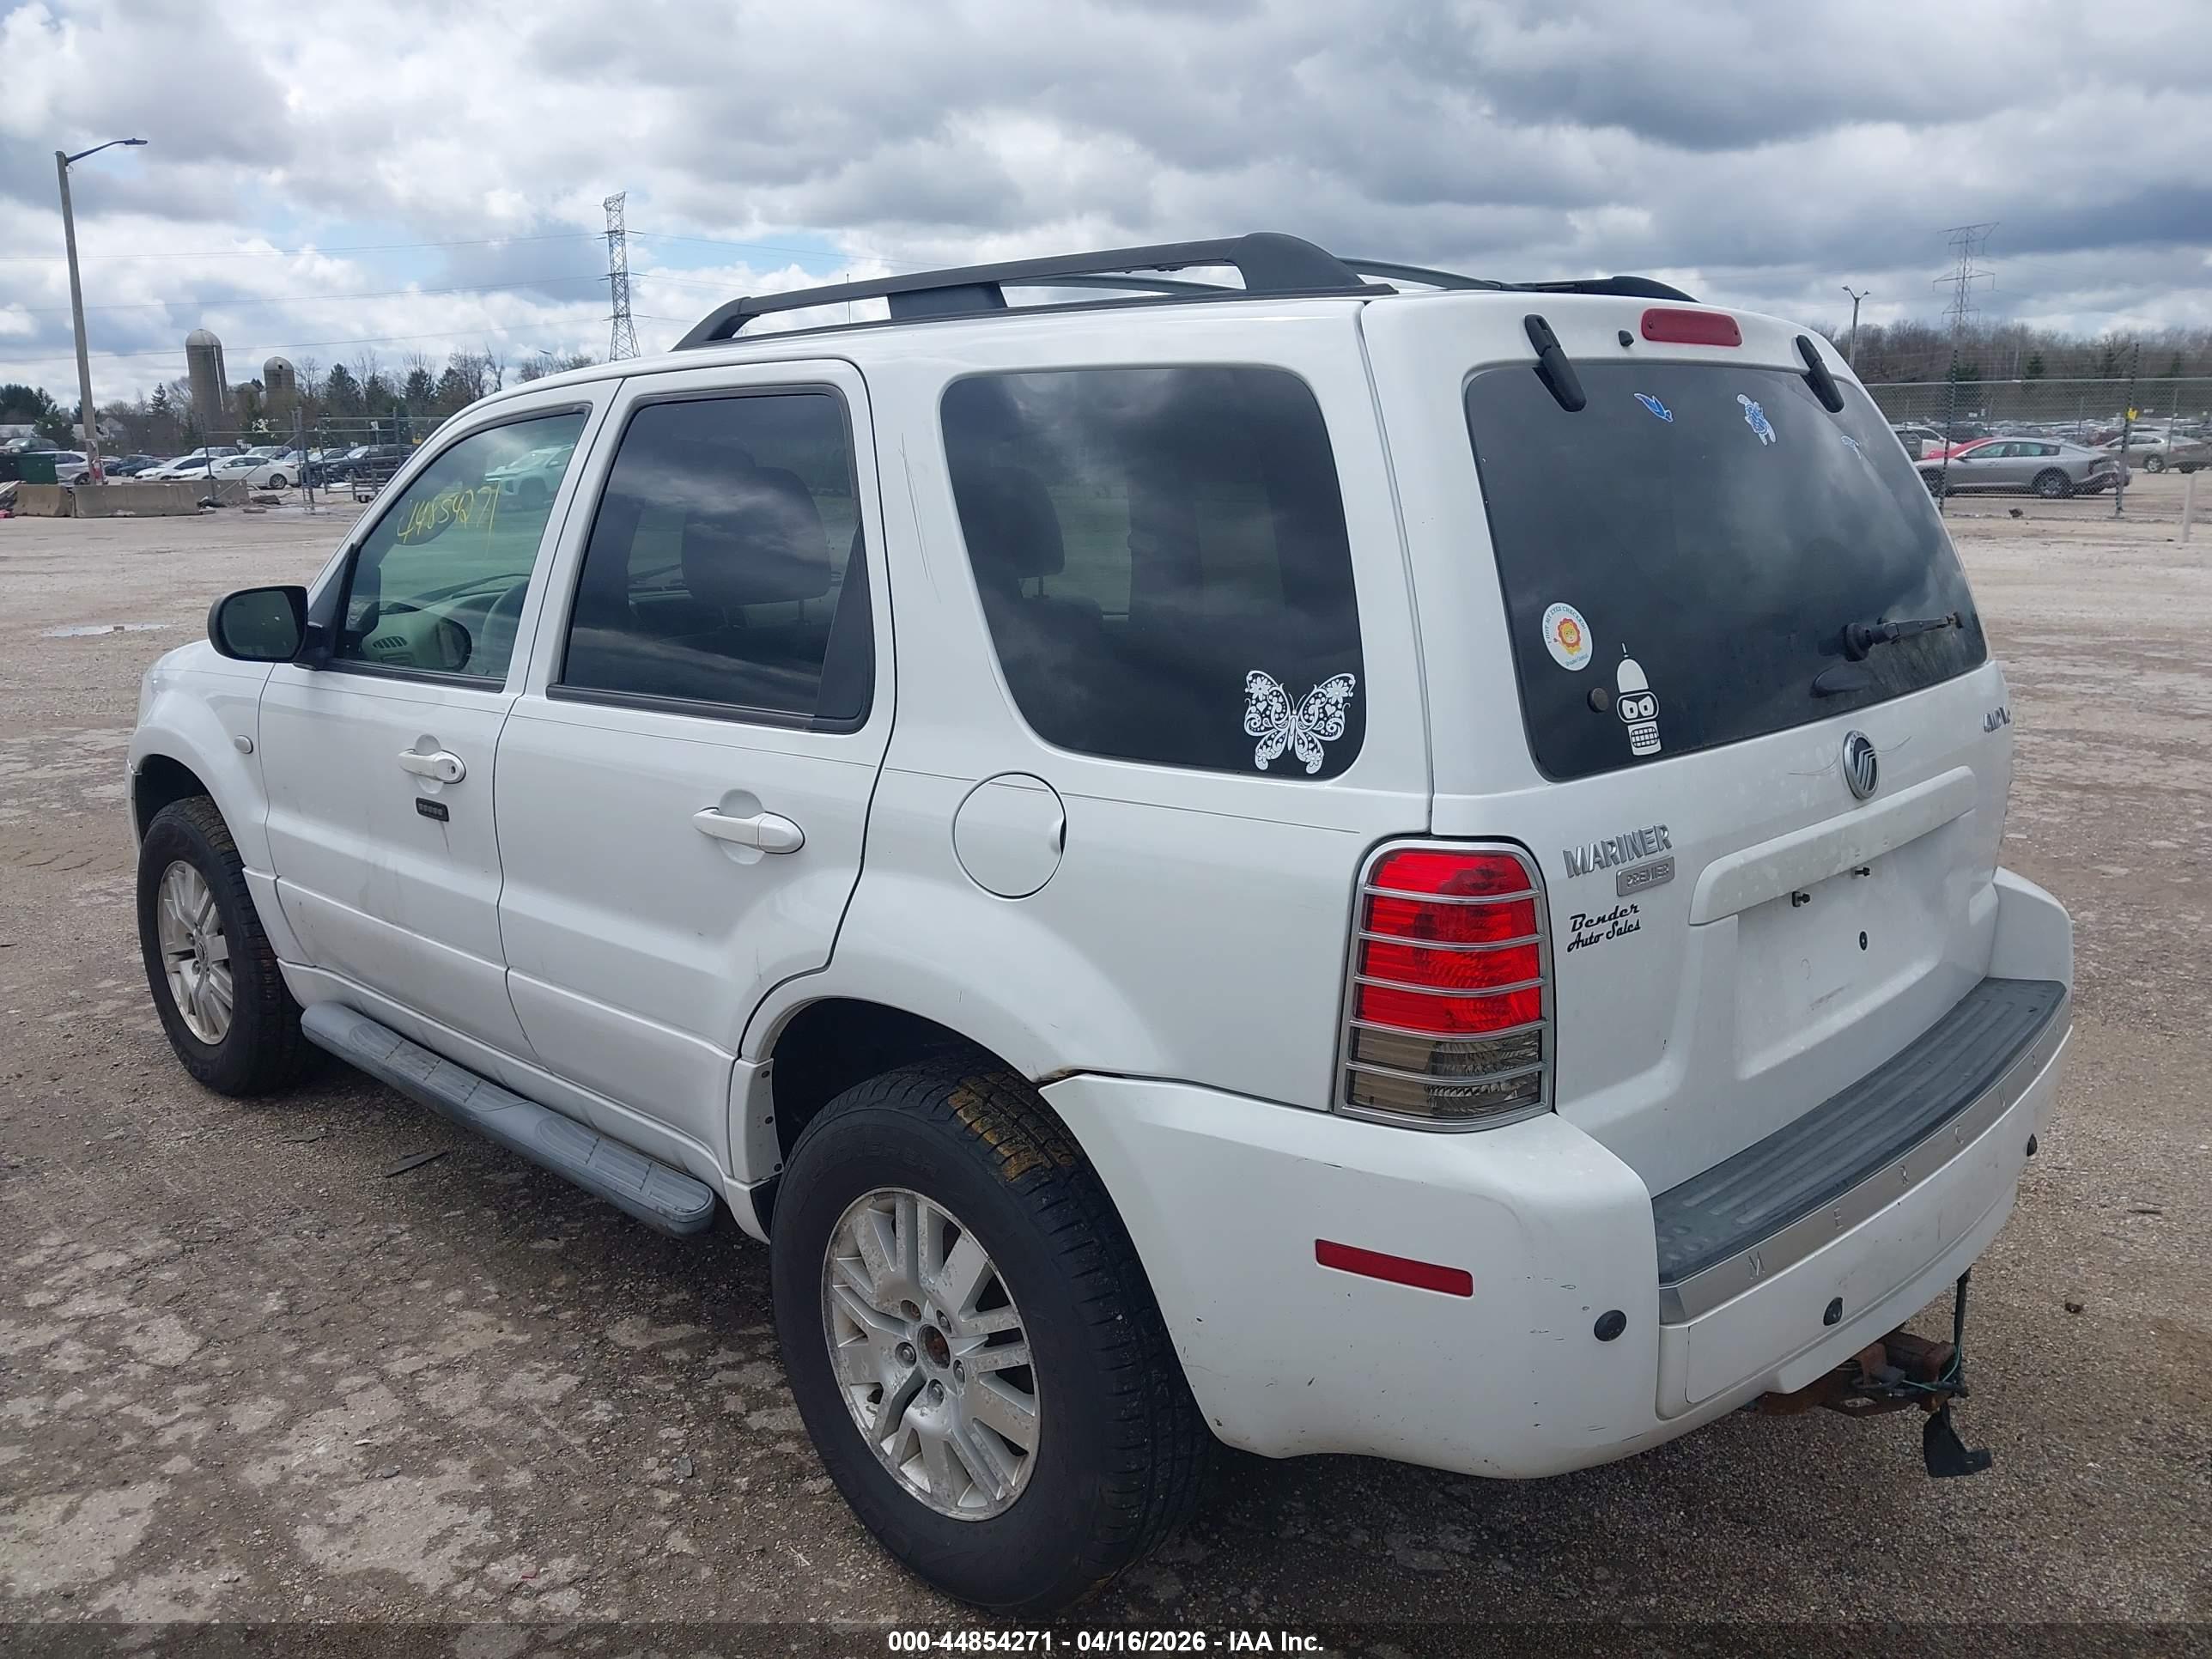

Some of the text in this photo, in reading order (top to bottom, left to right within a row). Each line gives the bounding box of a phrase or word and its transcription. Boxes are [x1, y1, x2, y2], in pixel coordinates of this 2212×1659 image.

[1563, 824, 1672, 878] MARINER
[1627, 863, 1669, 887] PREMIER
[1570, 903, 1640, 933] Bender
[1567, 919, 1641, 952] Auto Sales
